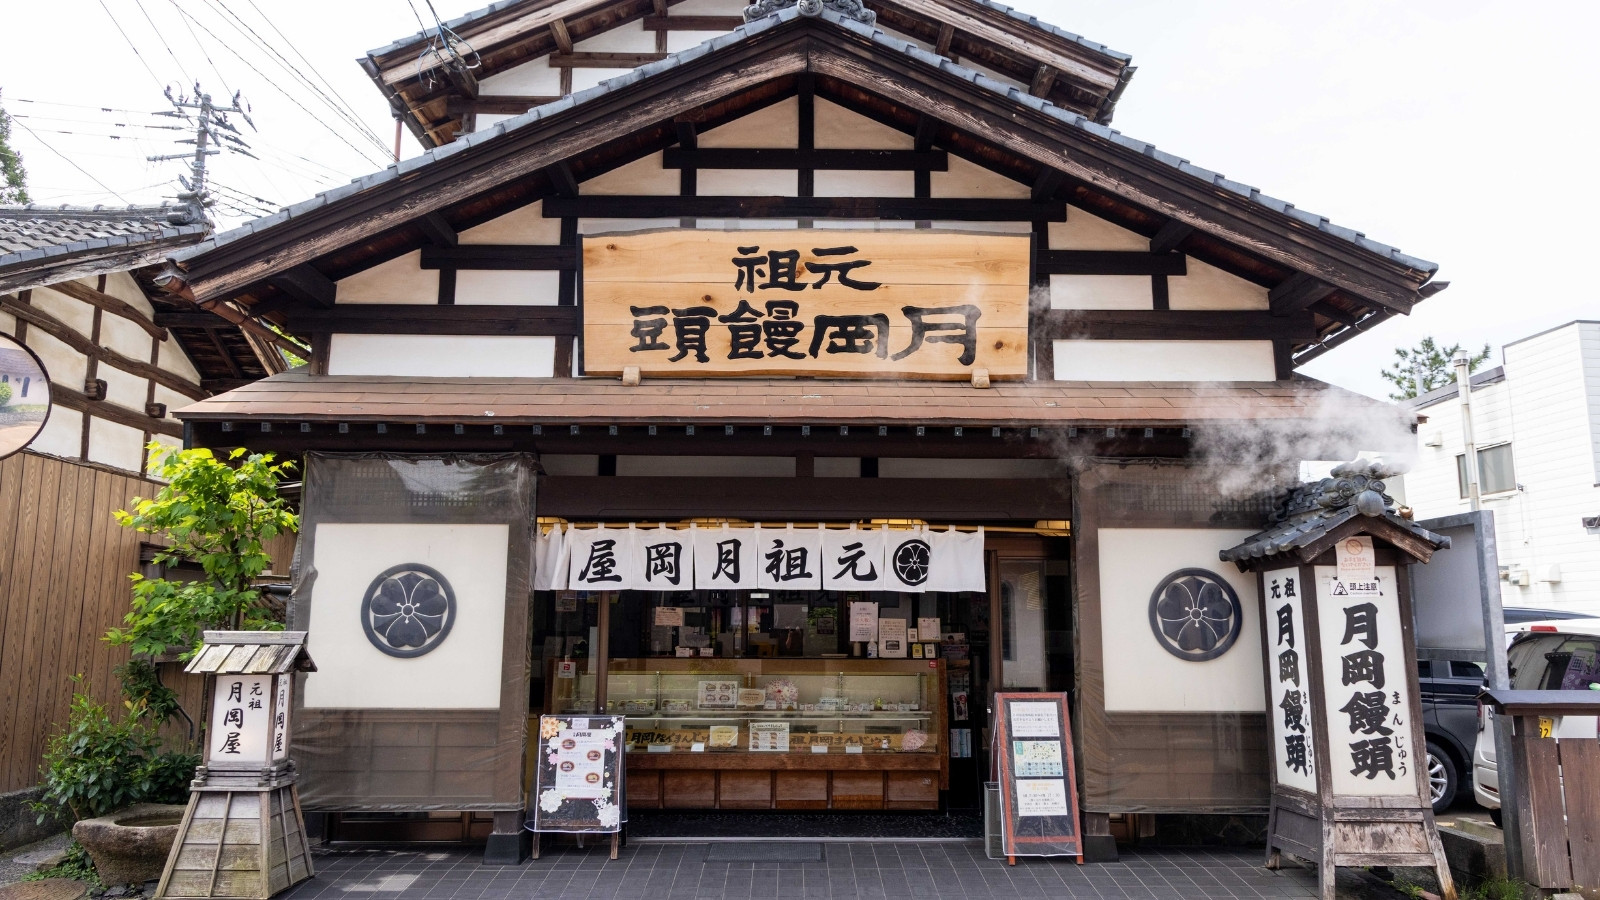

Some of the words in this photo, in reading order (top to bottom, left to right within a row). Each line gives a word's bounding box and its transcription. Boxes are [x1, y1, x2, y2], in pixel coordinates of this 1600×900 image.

[731, 245, 883, 293] 元祖
[1271, 577, 1296, 600] 元祖
[219, 682, 244, 754] 月岡屋
[248, 682, 263, 710] 元祖
[1276, 603, 1308, 777] 月岡饅頭
[1338, 602, 1396, 780] 月岡饅頭
[1392, 691, 1407, 777] まんじゅう
